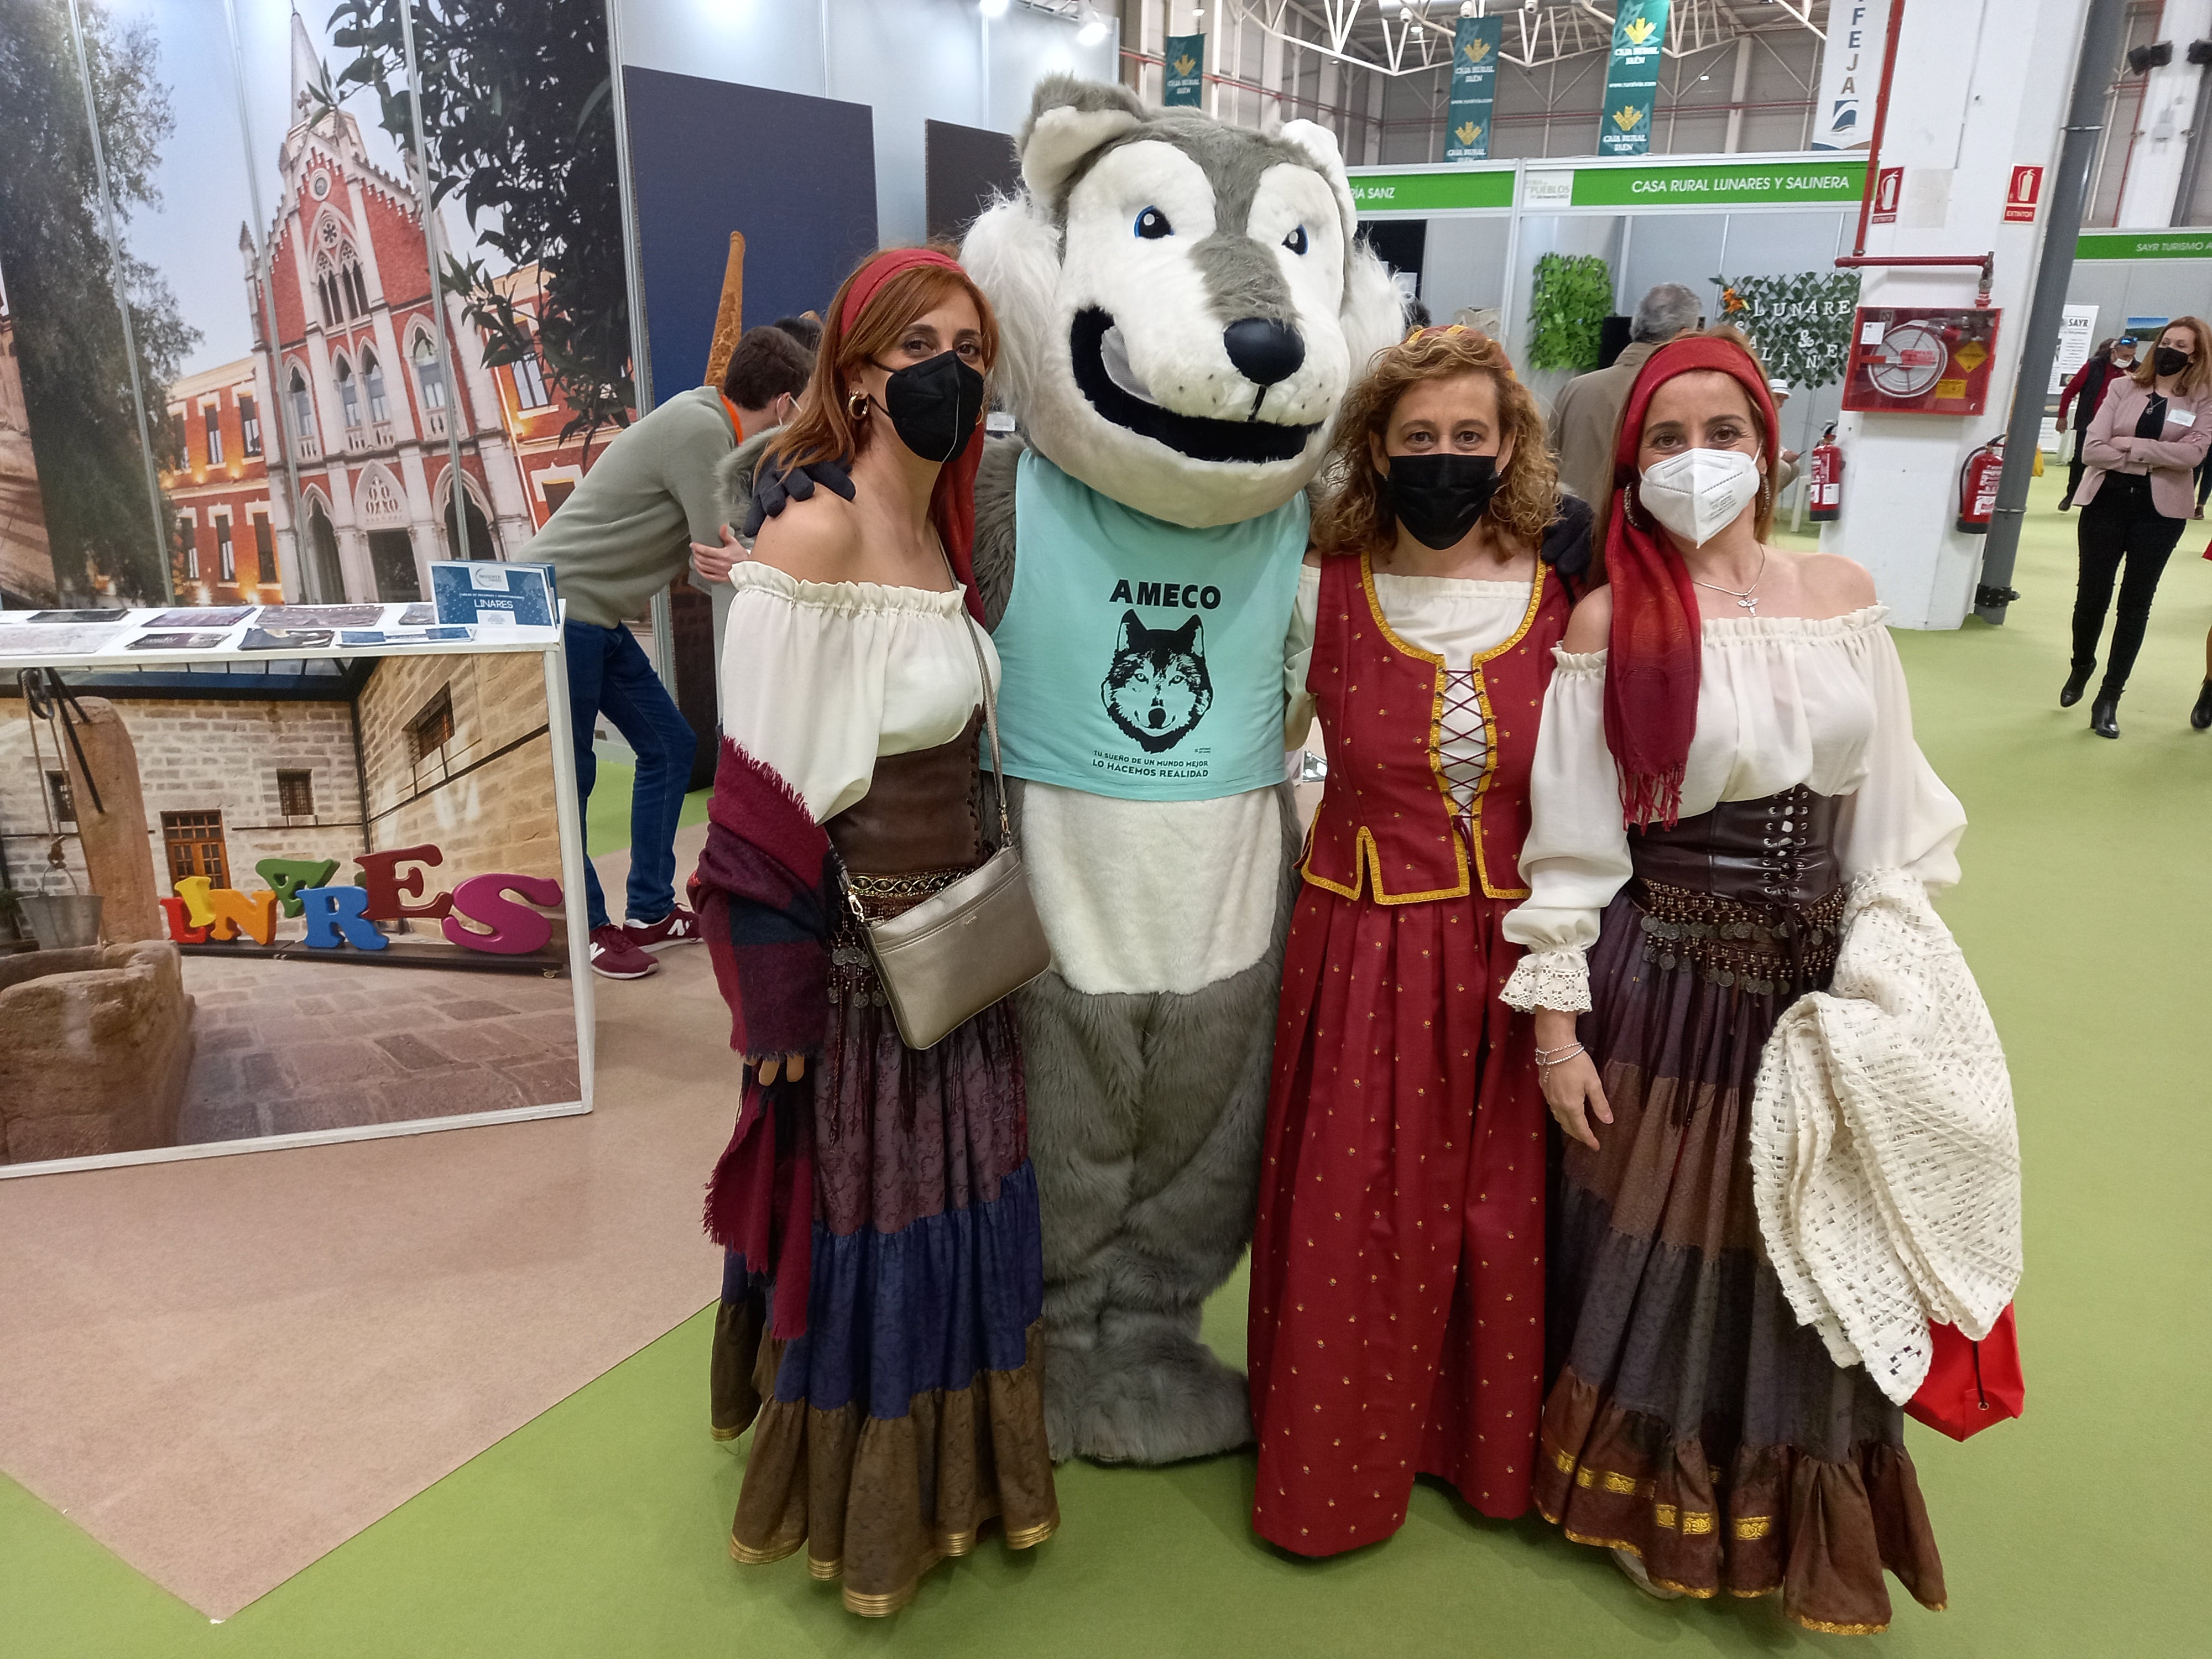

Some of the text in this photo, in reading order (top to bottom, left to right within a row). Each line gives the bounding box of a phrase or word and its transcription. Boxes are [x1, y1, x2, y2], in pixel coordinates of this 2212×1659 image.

[1841, 0, 1866, 94] FEJA
[1530, 185, 1570, 194] PUEBLOS
[1632, 176, 1850, 192] CASA RURAL LUNARES Y SALINERA
[1368, 187, 1396, 199] SANZ
[2136, 243, 2159, 252] SAYR
[2162, 242, 2204, 251] TURISMO
[2068, 318, 2089, 327] SAYR
[1798, 330, 1814, 348] &
[1109, 578, 1222, 610] AMECO
[474, 598, 513, 609] LINARES
[1104, 753, 1129, 762] SUEÑO
[1092, 759, 1209, 778] LO HACEMOS REALIDAD
[160, 844, 563, 954] LINARES
